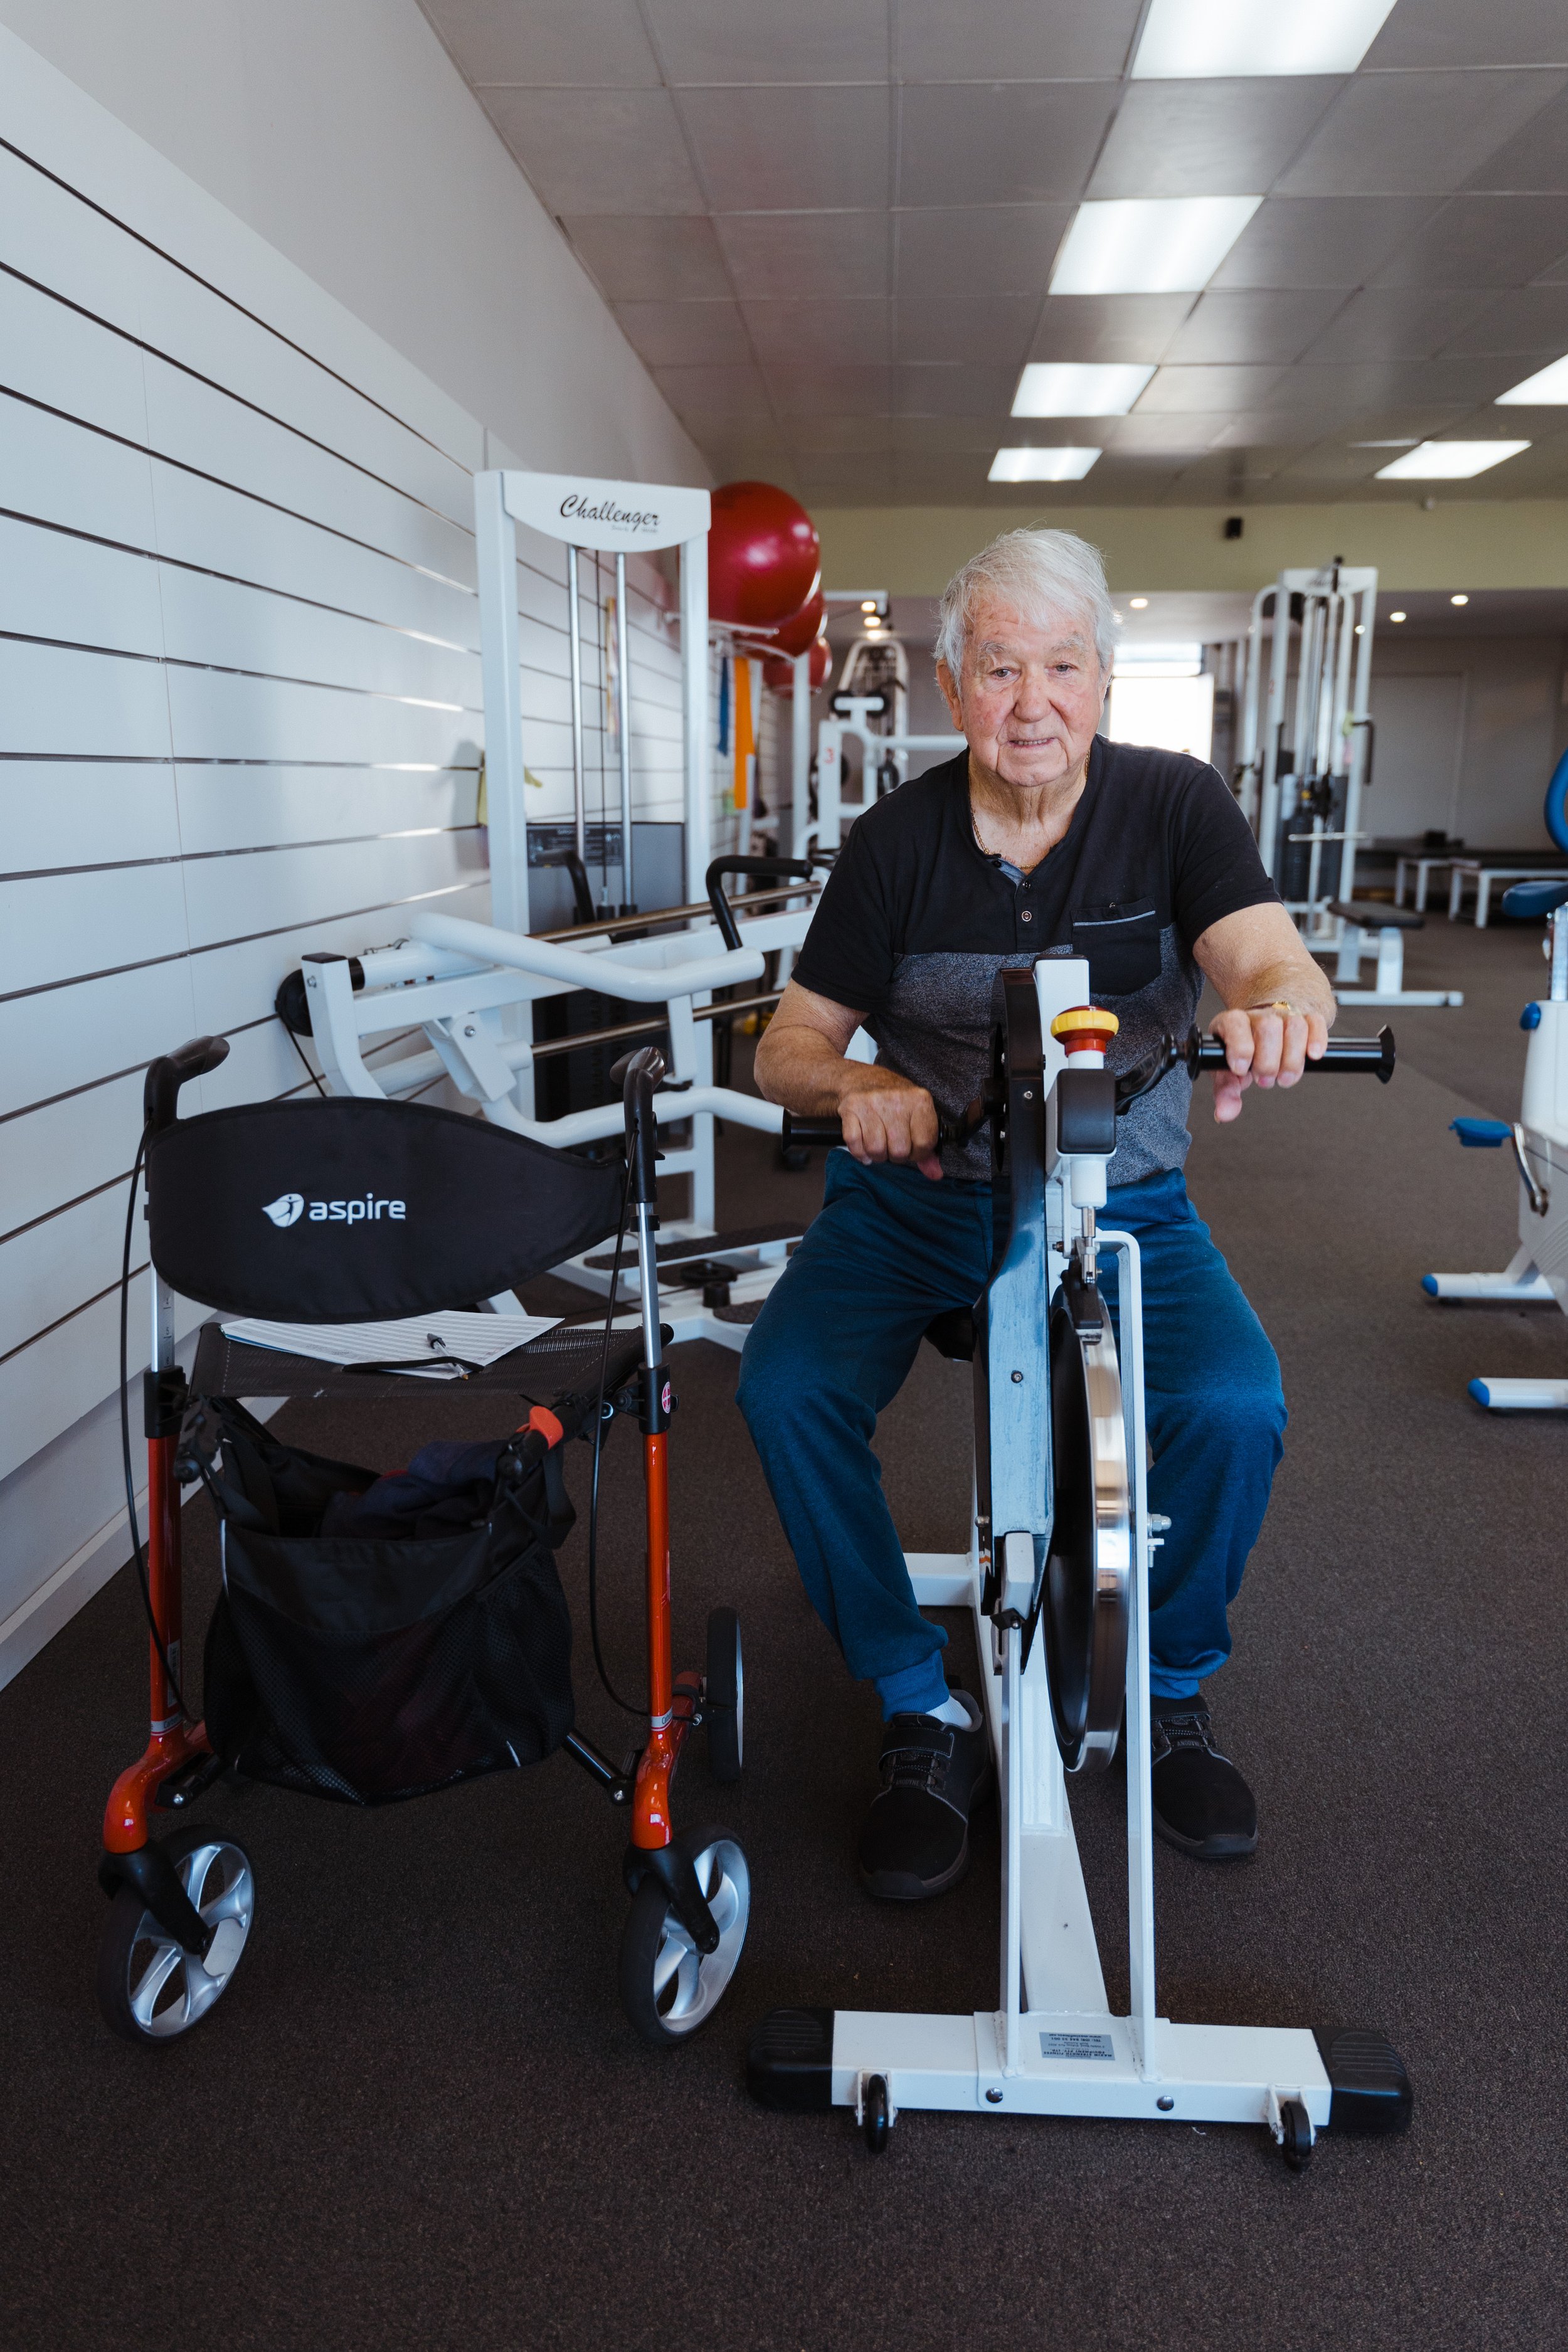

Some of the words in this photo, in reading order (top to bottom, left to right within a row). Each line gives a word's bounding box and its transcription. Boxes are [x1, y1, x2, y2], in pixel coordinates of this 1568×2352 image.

[560, 494, 660, 532] Challenger
[309, 1192, 406, 1225] aspire
[166, 1327, 170, 1335] 5
